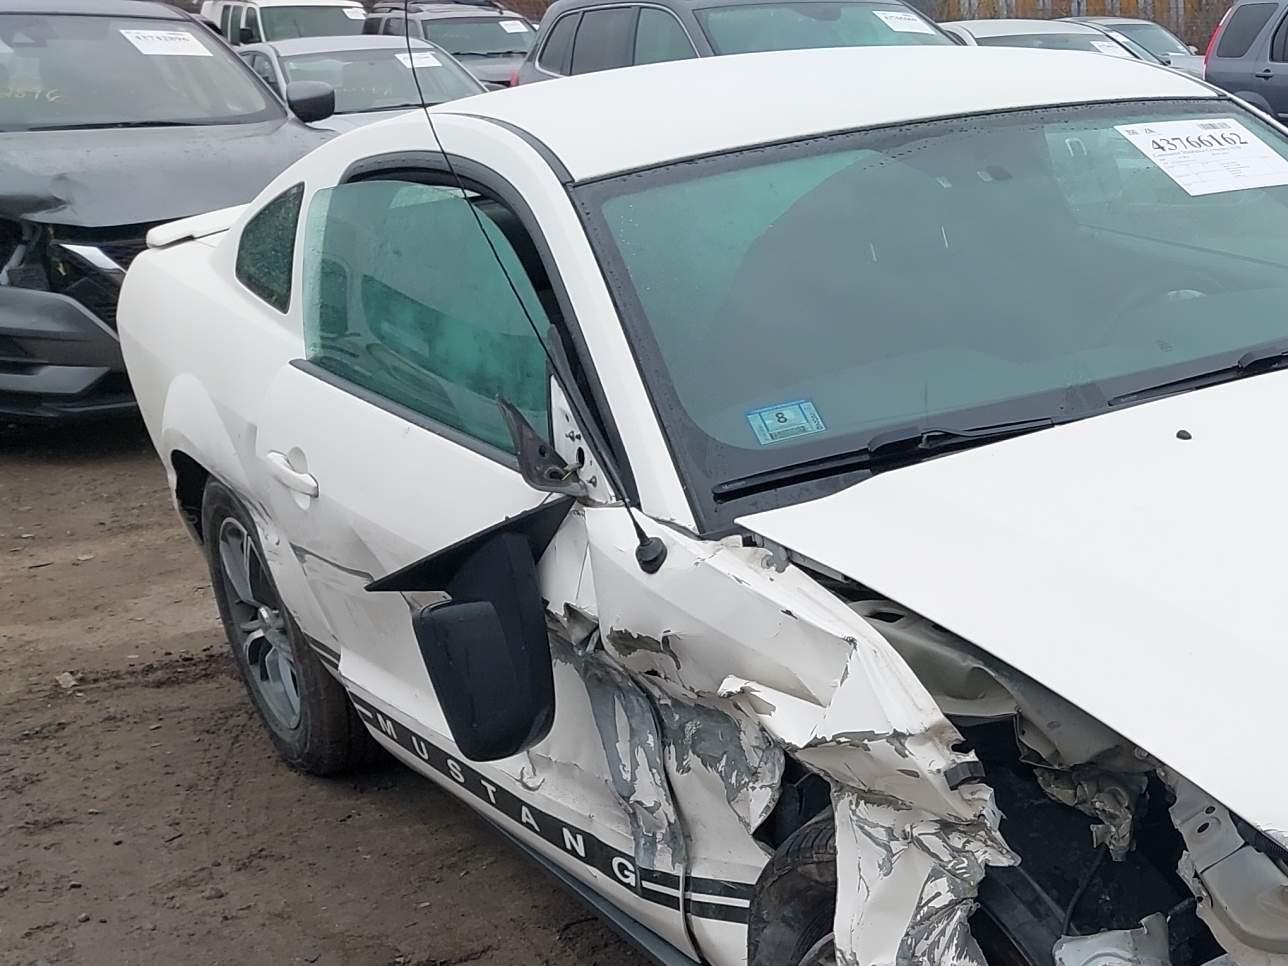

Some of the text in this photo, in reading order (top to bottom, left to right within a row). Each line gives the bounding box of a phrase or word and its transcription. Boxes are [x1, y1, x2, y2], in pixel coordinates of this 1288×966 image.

[1151, 132, 1248, 152] 43766162
[775, 412, 788, 424] 8
[376, 713, 637, 887] MUSTANG
